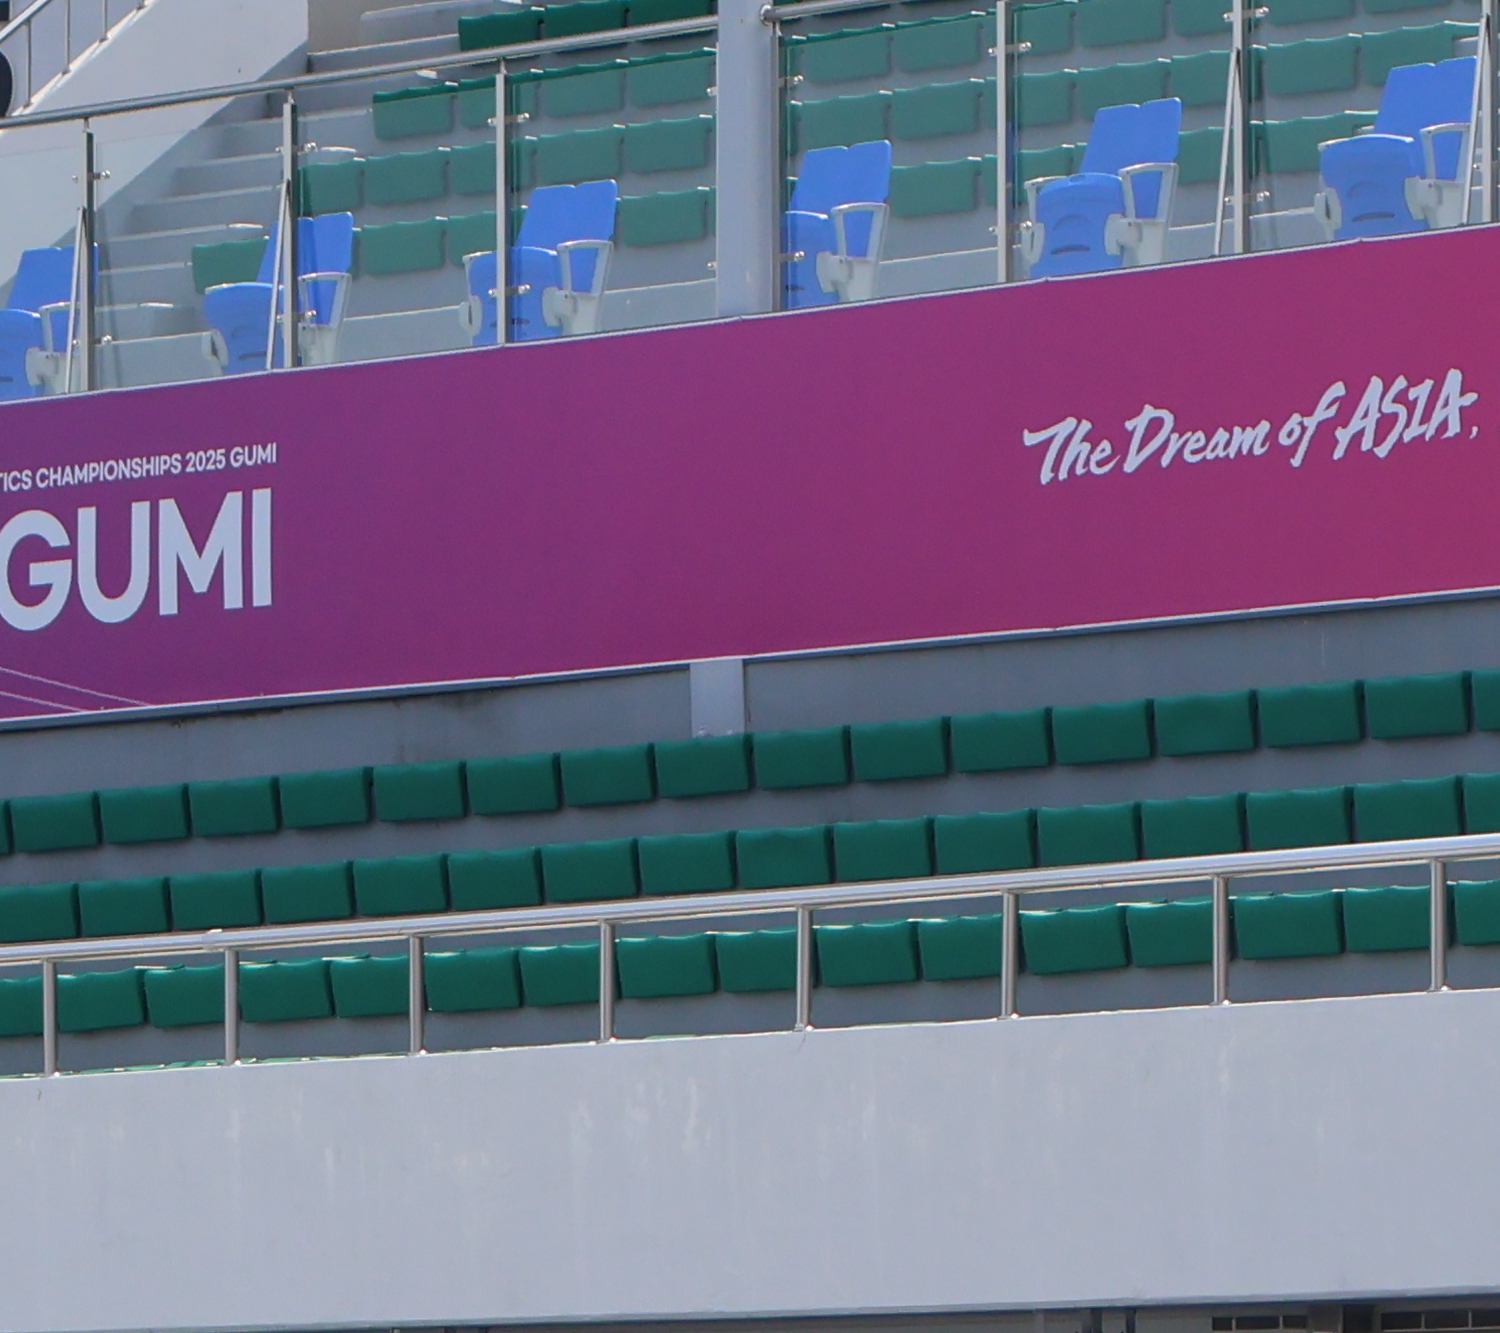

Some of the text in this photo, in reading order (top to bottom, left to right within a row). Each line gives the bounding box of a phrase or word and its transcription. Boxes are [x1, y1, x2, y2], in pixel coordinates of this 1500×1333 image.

[35, 452, 183, 489] CHAMPIONSHIPS
[185, 446, 228, 473] 2025
[229, 441, 278, 468] GUMI
[1022, 415, 1120, 486] The
[1123, 403, 1271, 474] Dream
[1278, 380, 1347, 468] of
[1332, 367, 1480, 461] ASIA,
